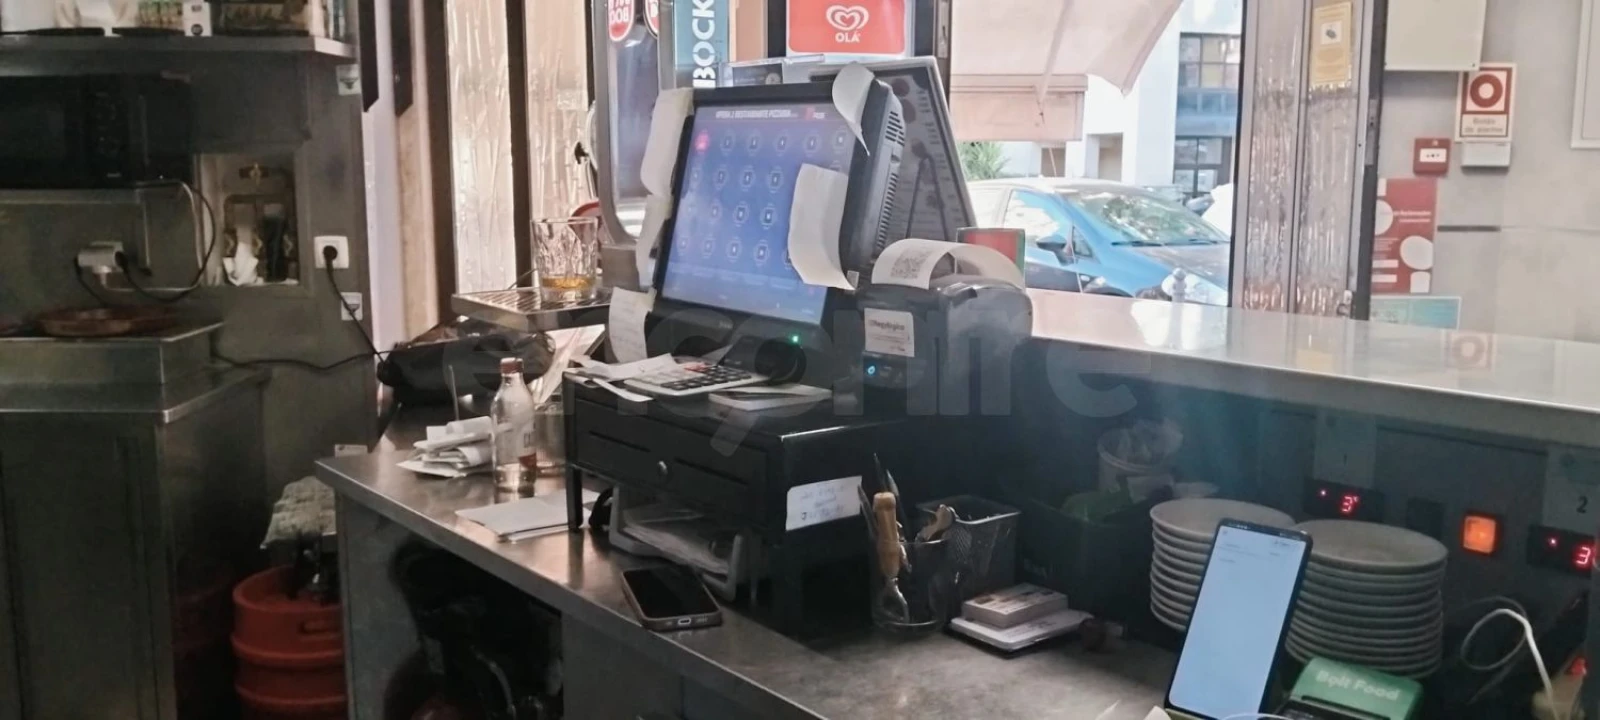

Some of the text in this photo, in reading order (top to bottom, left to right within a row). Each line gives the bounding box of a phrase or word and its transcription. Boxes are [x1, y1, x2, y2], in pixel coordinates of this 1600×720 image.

[835, 30, 860, 43] OLÁ
[1576, 495, 1588, 514] 2
[1352, 679, 1401, 701] Food
